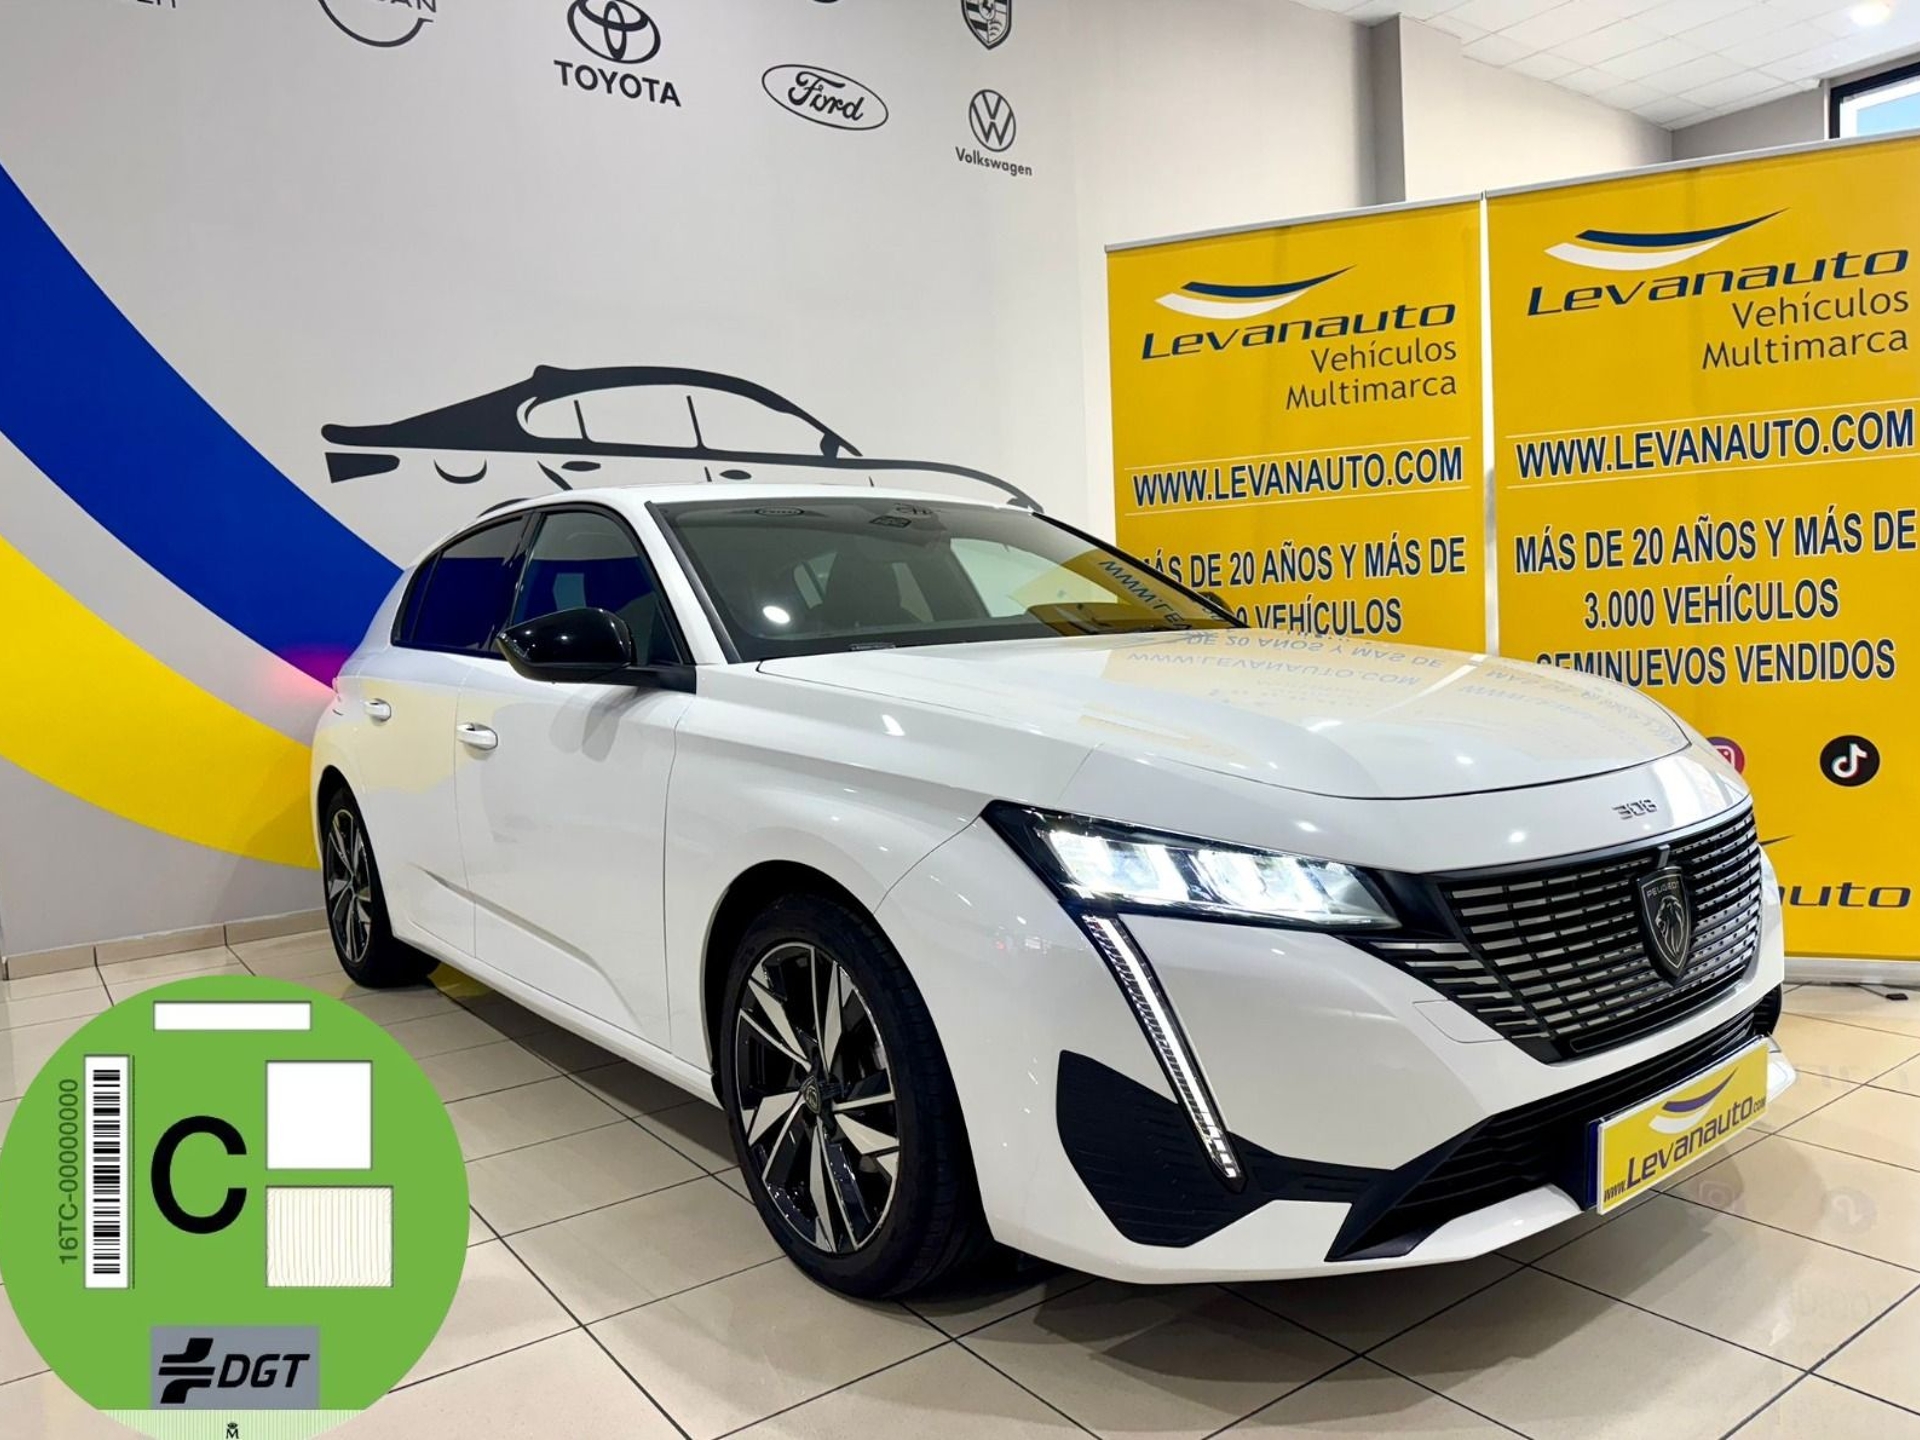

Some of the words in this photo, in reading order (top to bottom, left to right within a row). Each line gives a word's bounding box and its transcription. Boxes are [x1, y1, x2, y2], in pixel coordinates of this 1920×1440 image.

[553, 59, 682, 108] TOYOTA
[787, 70, 865, 121] Ford
[955, 146, 1033, 177] Volkswagen
[1527, 249, 1909, 317] Levanauto
[1141, 303, 1456, 360] Levanauto
[1731, 287, 1909, 330] Vehículos
[1310, 337, 1457, 374] Vehículos
[1702, 329, 1909, 370] Multimarca
[1286, 375, 1457, 411] Multimarca
[1516, 408, 1914, 479] WWW.LEVANAUTO.COM
[1133, 446, 1463, 507] WWW.LEVANAUTO.COM
[1143, 549, 1182, 584] ÁS
[1190, 553, 1222, 588] DE
[1229, 551, 1256, 586] 20
[1262, 541, 1333, 584] AÑOS
[1340, 544, 1357, 579] Y
[1364, 532, 1421, 578] MÁS
[1430, 537, 1466, 574] DE
[1515, 525, 1576, 573] MÁS
[1586, 530, 1624, 569] DE
[1633, 527, 1664, 566] 20
[1672, 515, 1757, 564] AÑOS
[1764, 518, 1786, 557] Y
[1795, 505, 1863, 556] MÁS
[1874, 509, 1917, 551] DE
[1255, 594, 1402, 636] VEHÍCULOS
[1584, 588, 1655, 629] 3.000
[1662, 574, 1839, 624] VEHÍCULOS
[1735, 639, 1896, 683] VENDIDOS
